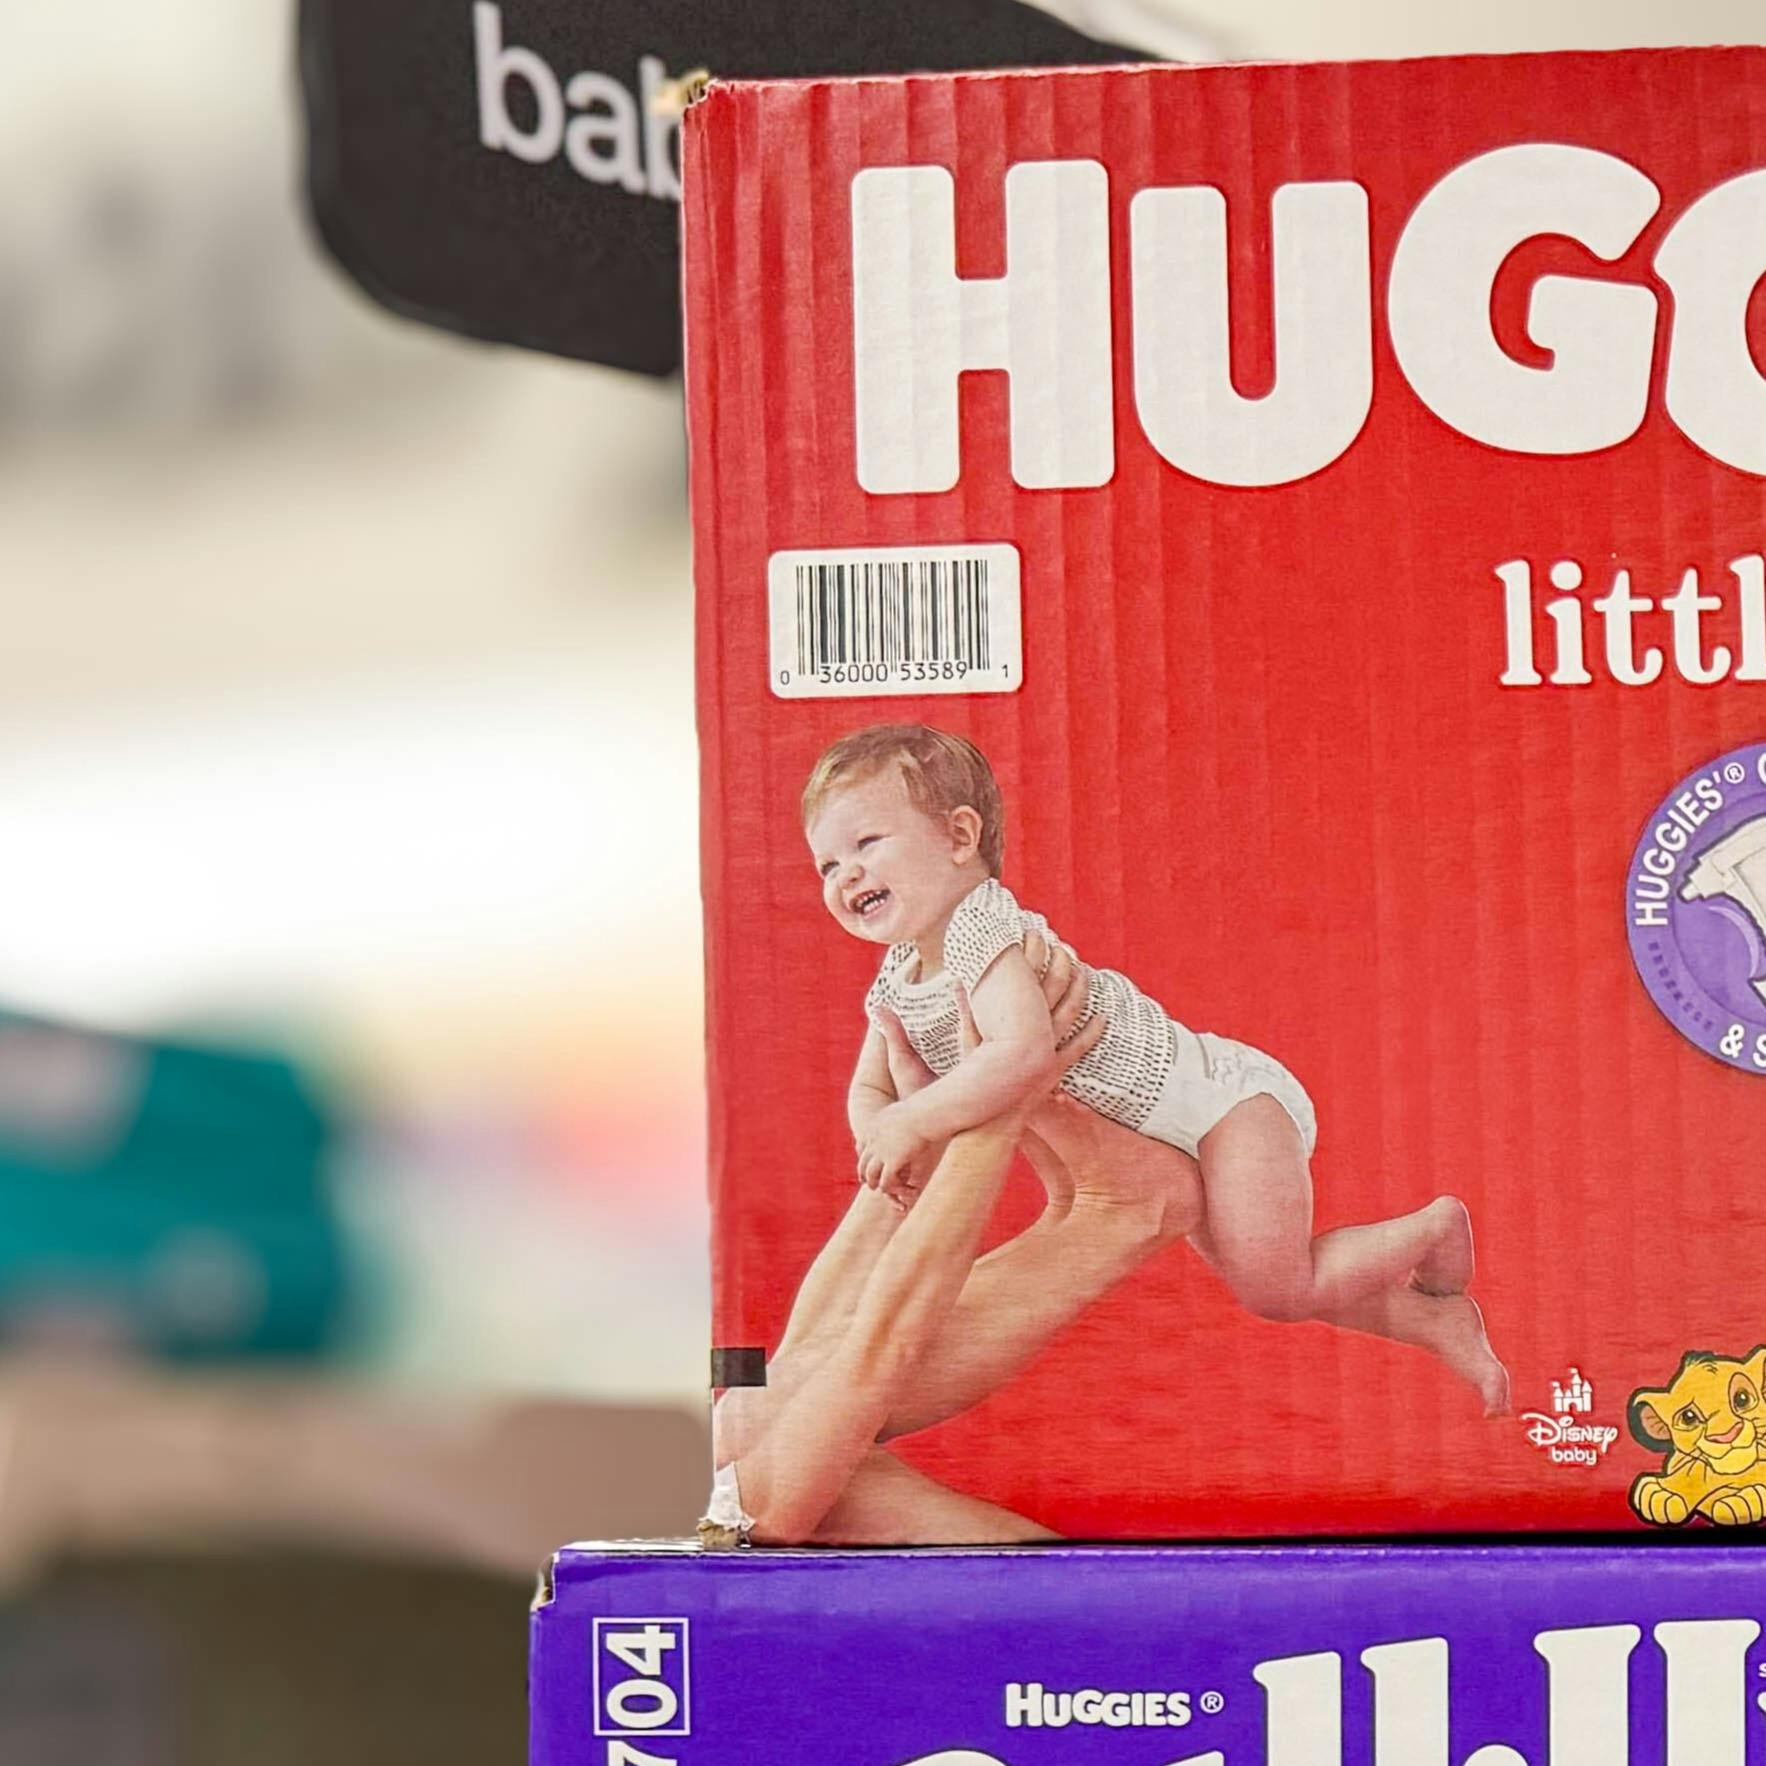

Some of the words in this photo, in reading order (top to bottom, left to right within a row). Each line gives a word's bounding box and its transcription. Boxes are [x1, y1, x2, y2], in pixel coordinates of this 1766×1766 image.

[780, 670, 790, 685] 0
[820, 664, 888, 683] 36000
[900, 661, 967, 680] 53589
[1002, 664, 1008, 678] 1
[1720, 1024, 1745, 1058] &
[1551, 1447, 1597, 1465] baby
